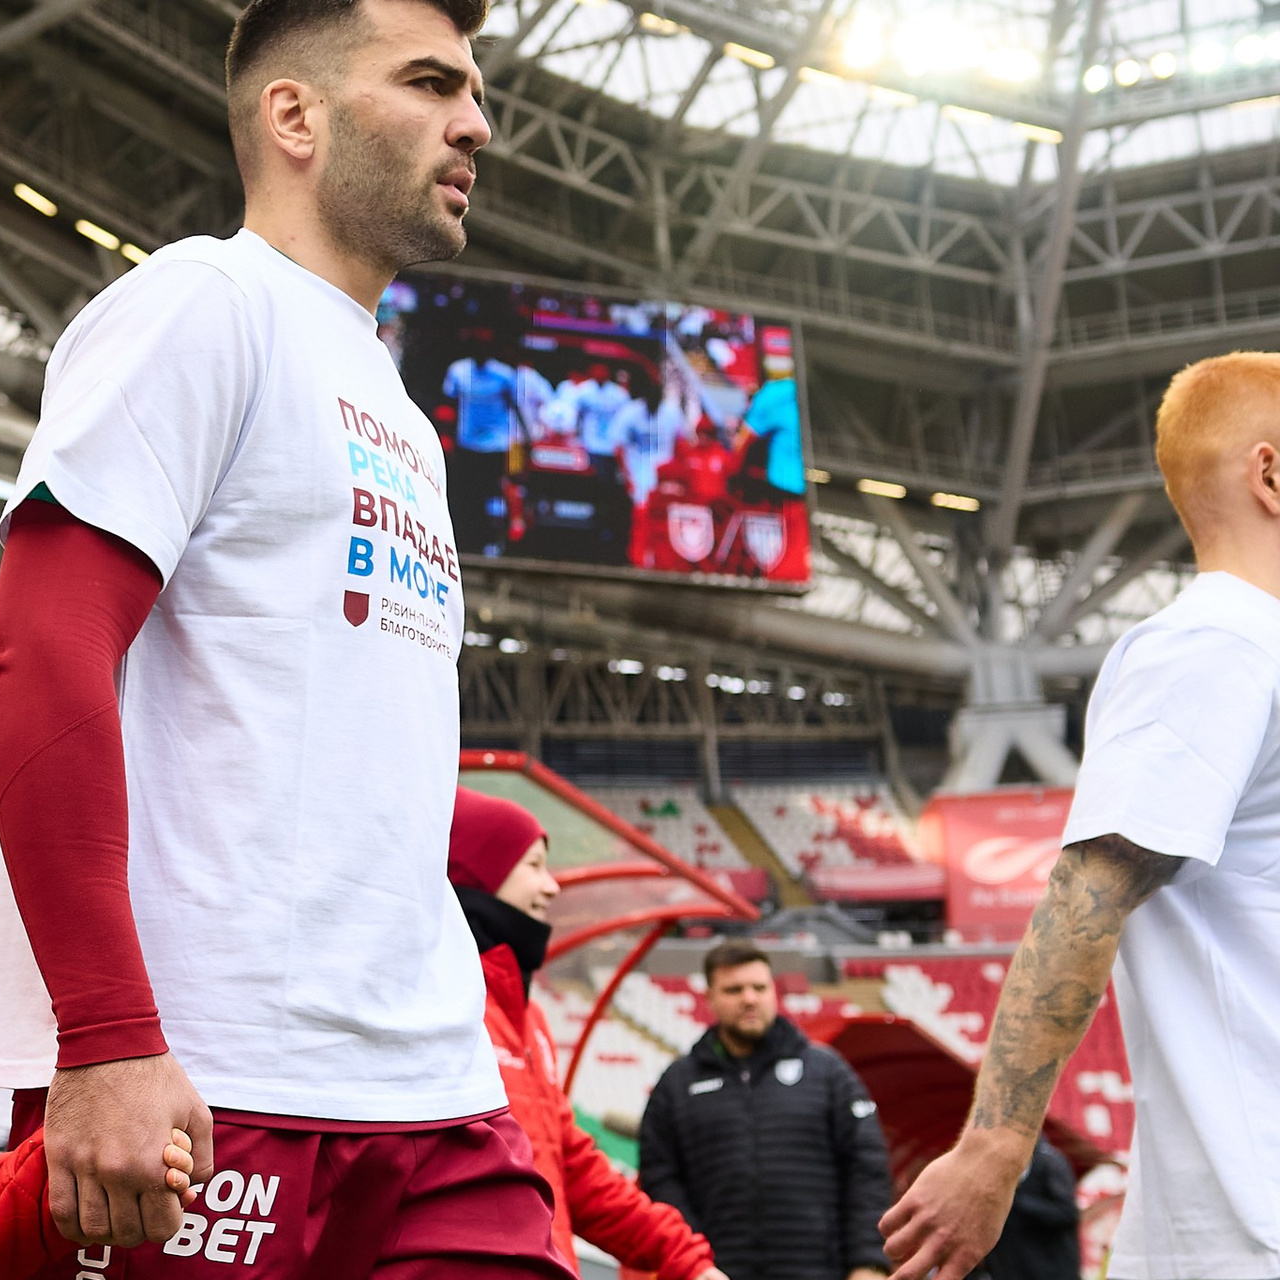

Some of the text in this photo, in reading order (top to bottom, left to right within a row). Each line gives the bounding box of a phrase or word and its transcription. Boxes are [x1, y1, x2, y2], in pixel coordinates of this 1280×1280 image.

[337, 397, 442, 498] ПОМОЩ
[347, 440, 420, 512] РЕКА
[347, 535, 375, 578] В
[352, 487, 459, 583] ВПАДАЕ
[190, 1169, 281, 1218] ON
[162, 1212, 277, 1266] BET
